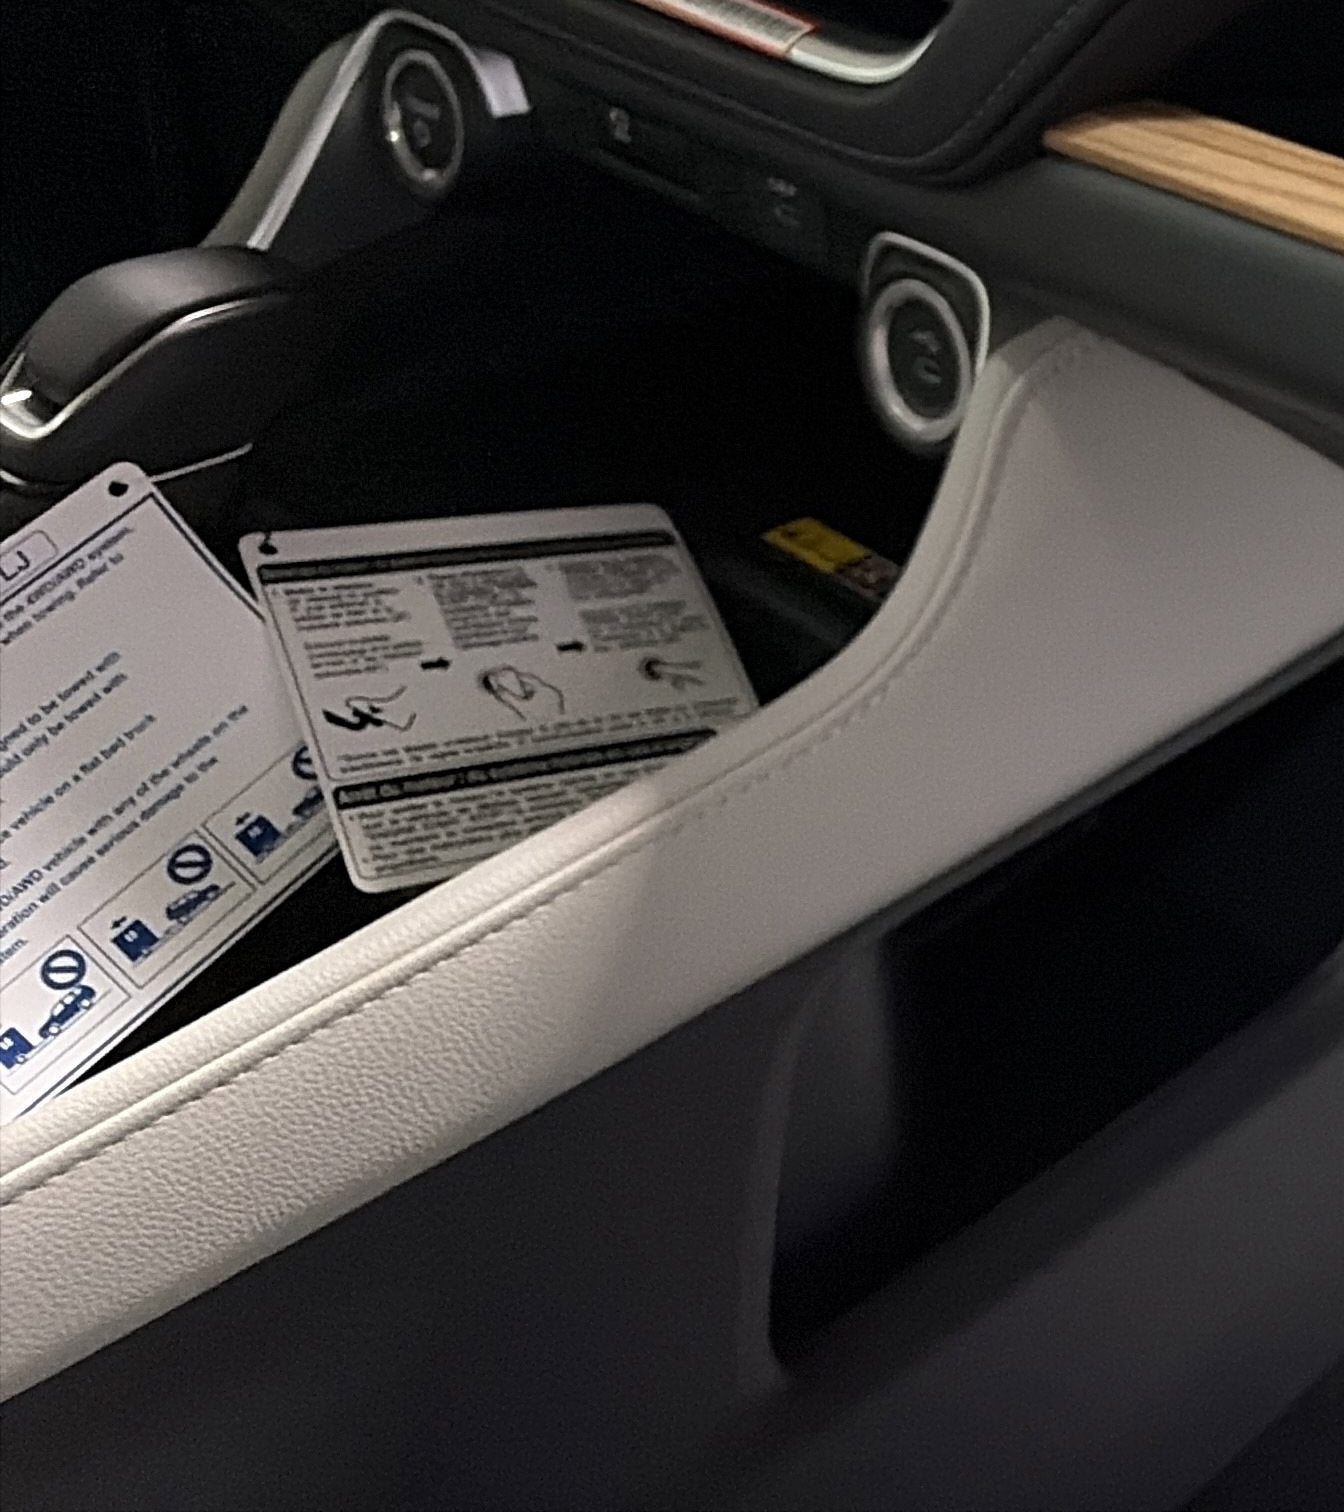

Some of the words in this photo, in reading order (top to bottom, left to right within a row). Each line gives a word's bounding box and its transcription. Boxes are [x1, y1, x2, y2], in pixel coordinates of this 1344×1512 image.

[22, 734, 49, 756] only
[47, 722, 65, 736] be
[64, 692, 101, 722] towed
[26, 712, 42, 726] to
[39, 700, 59, 715] be
[57, 670, 95, 702] towed
[10, 795, 55, 830] vehicle
[54, 780, 71, 797] on
[100, 737, 126, 759] bed
[0, 868, 43, 909] D/AWD
[43, 836, 87, 871] vehicle
[87, 814, 113, 836] with
[136, 781, 150, 797] of
[149, 768, 170, 785] the
[38, 882, 61, 904] will
